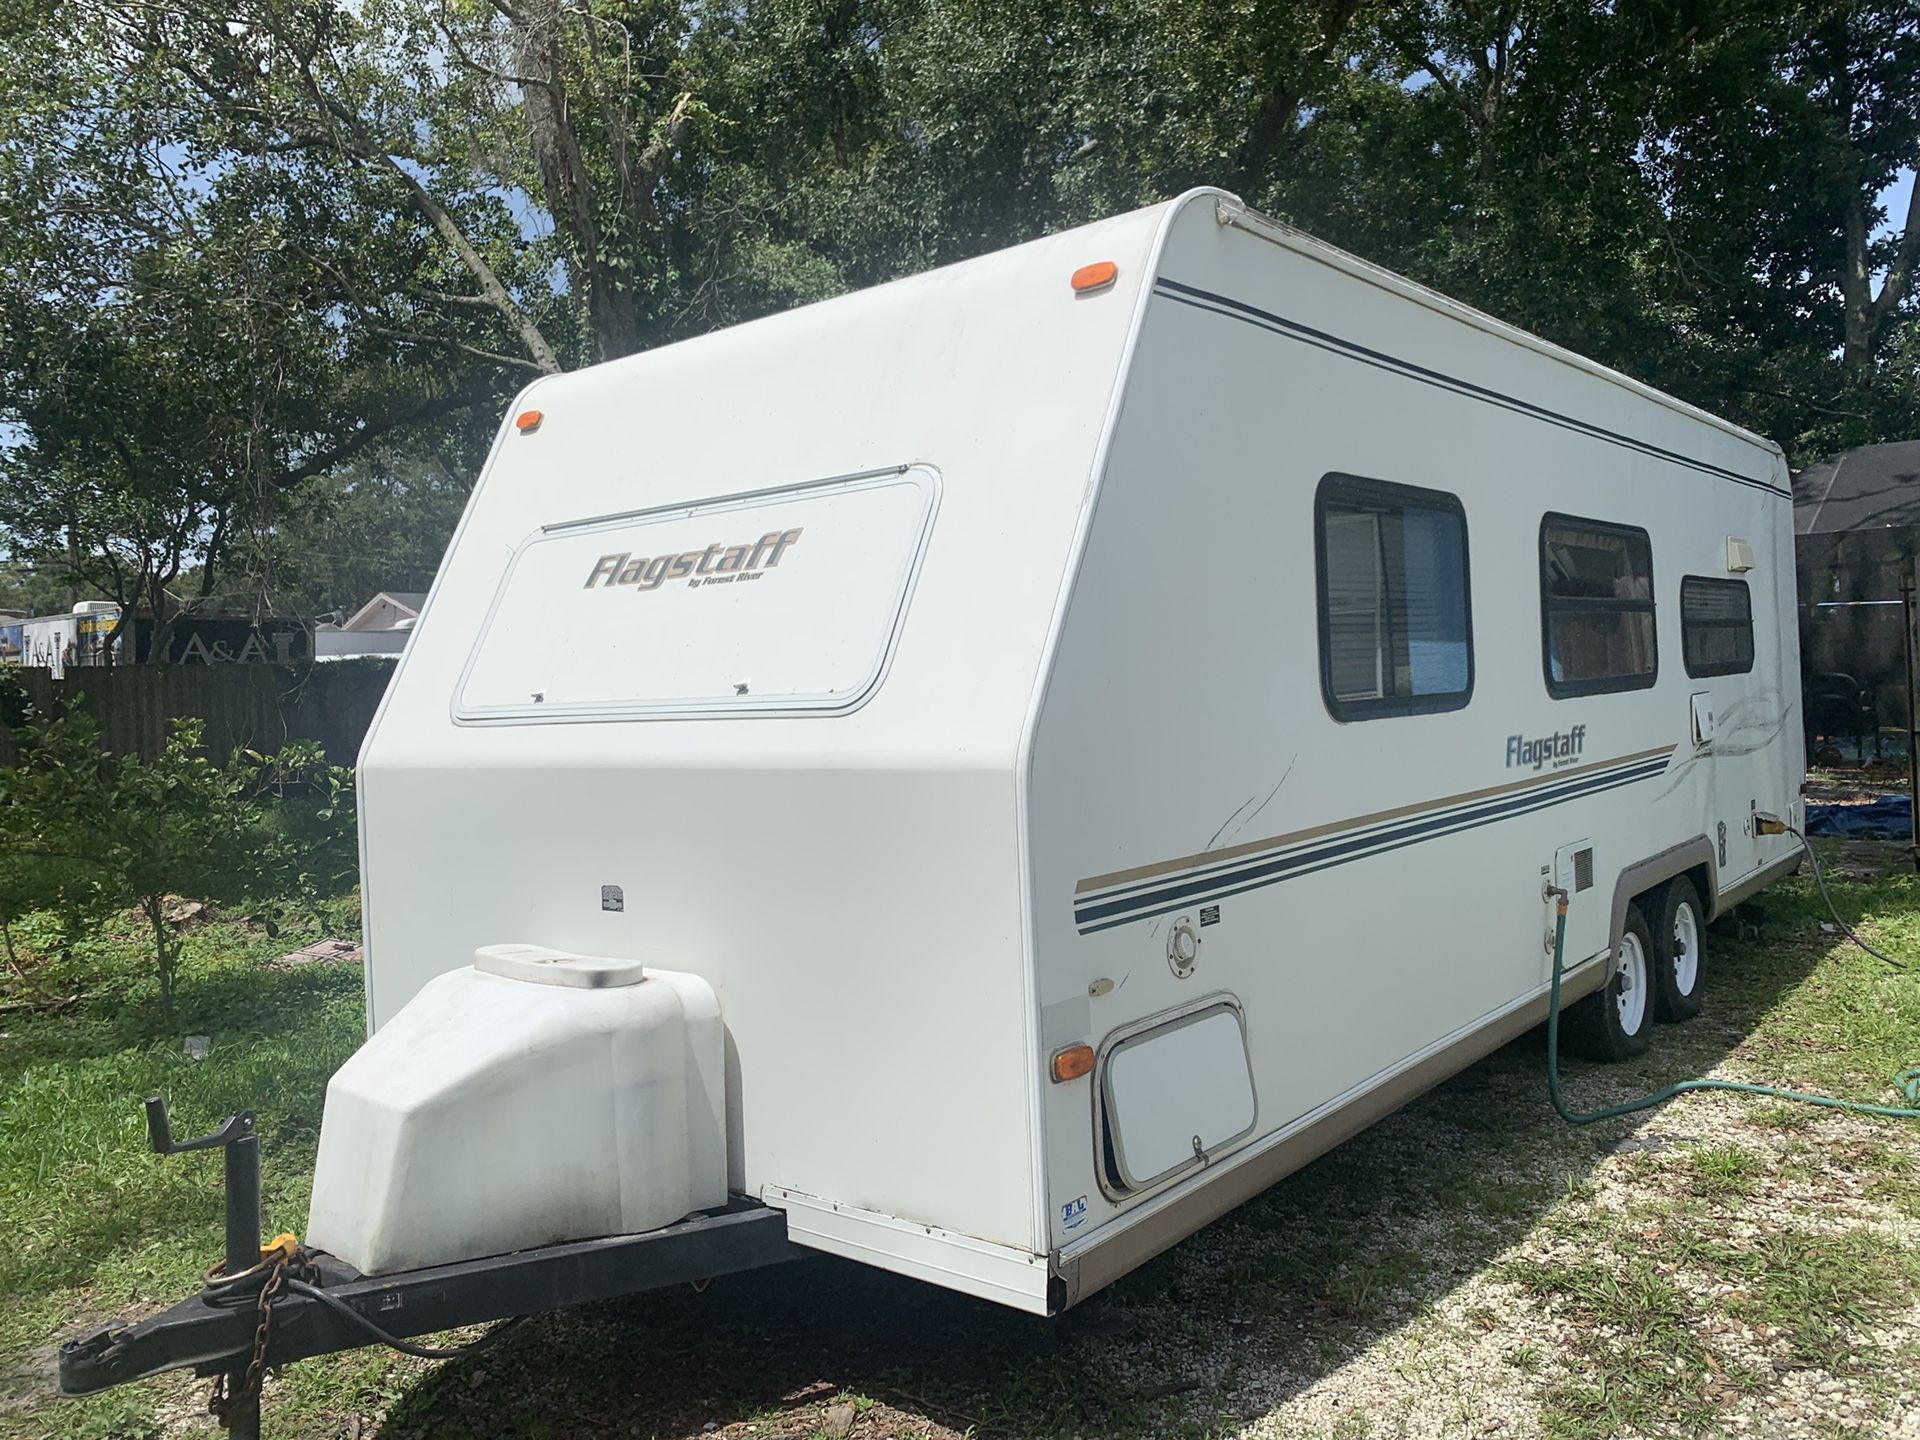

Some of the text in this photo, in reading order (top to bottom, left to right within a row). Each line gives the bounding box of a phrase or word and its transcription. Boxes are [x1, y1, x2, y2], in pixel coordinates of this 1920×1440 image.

[583, 527, 804, 592] Flagstaff
[688, 571, 764, 588] by Forest River
[178, 632, 269, 665] A&A
[1505, 724, 1586, 771] Flagstaff
